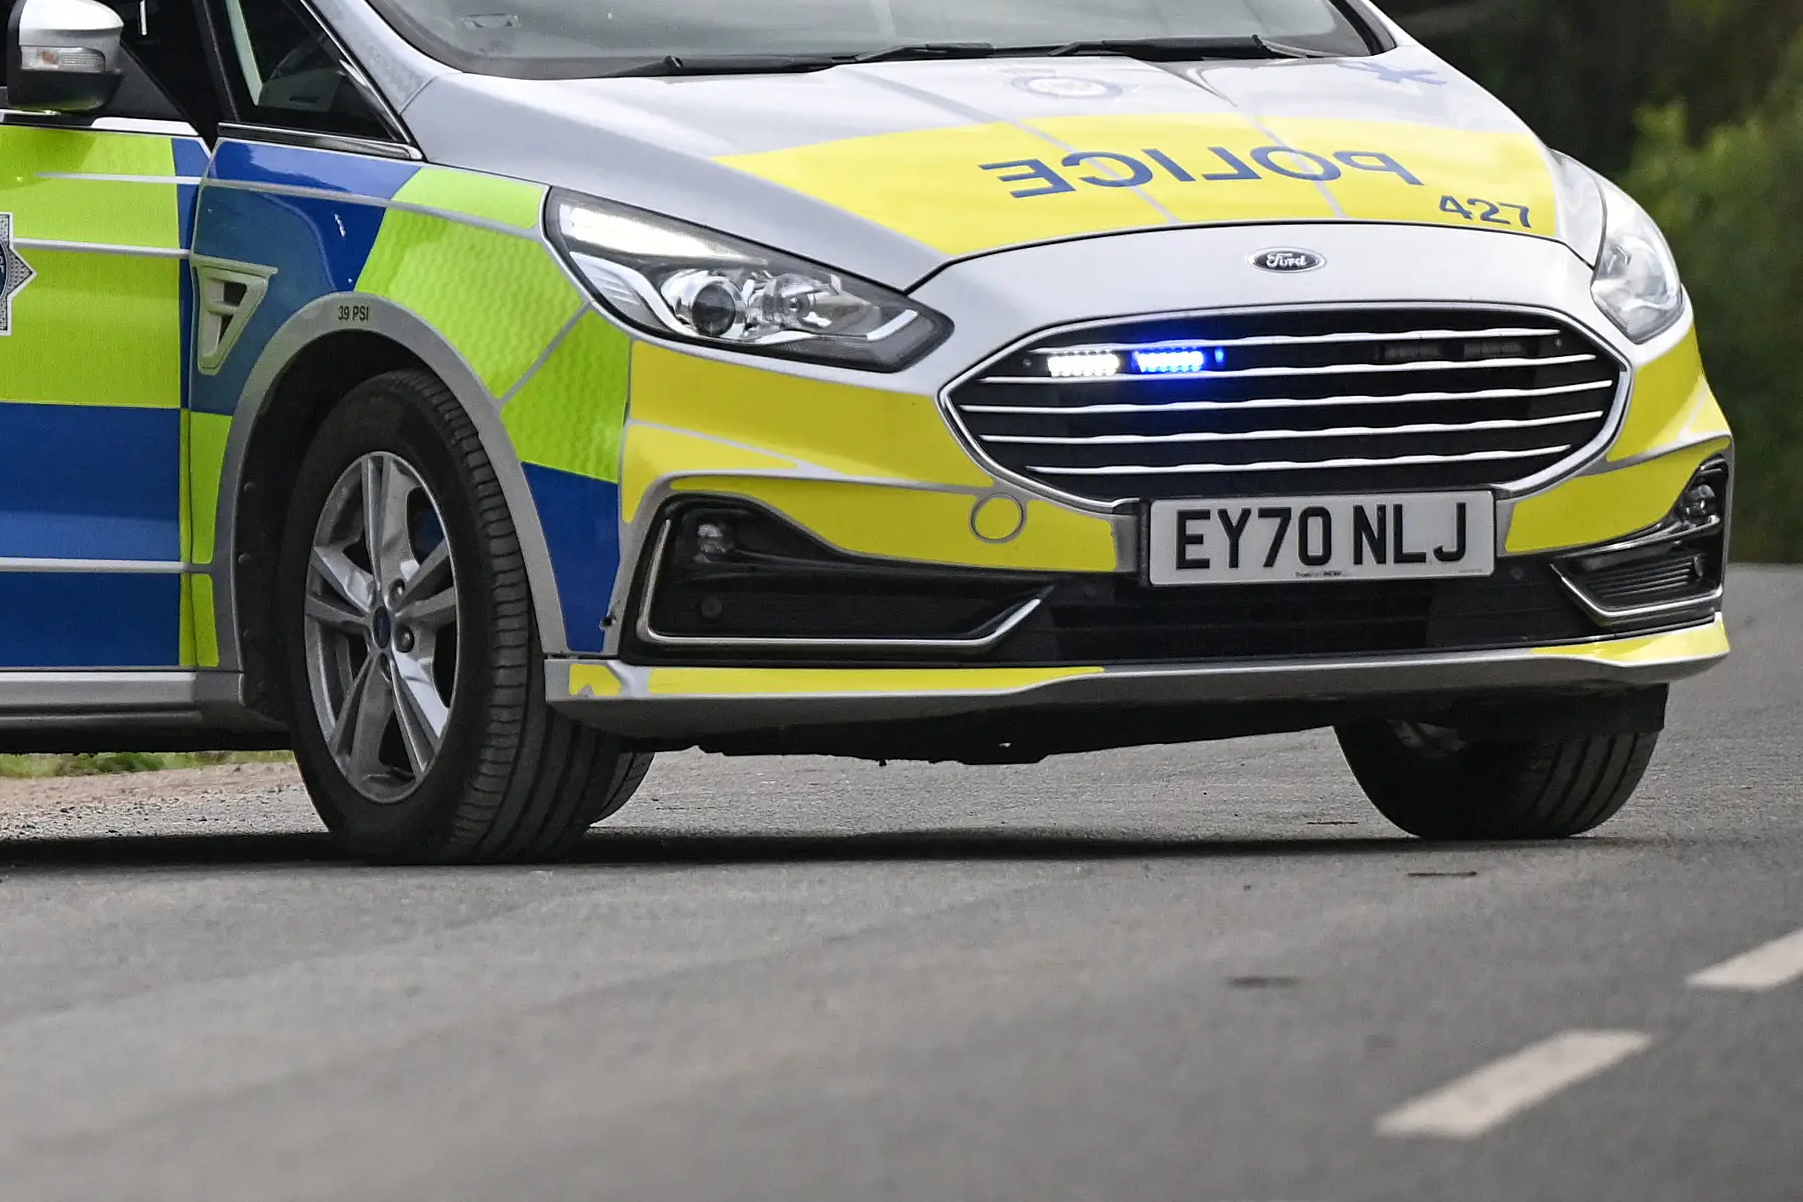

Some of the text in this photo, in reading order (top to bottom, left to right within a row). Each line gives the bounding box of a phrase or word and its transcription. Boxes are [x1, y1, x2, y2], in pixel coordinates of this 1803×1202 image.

[1438, 194, 1532, 229] 427
[1265, 252, 1308, 268] Ford
[338, 305, 370, 321] 39 PSI
[1175, 502, 1467, 571] EY70 NLJ
